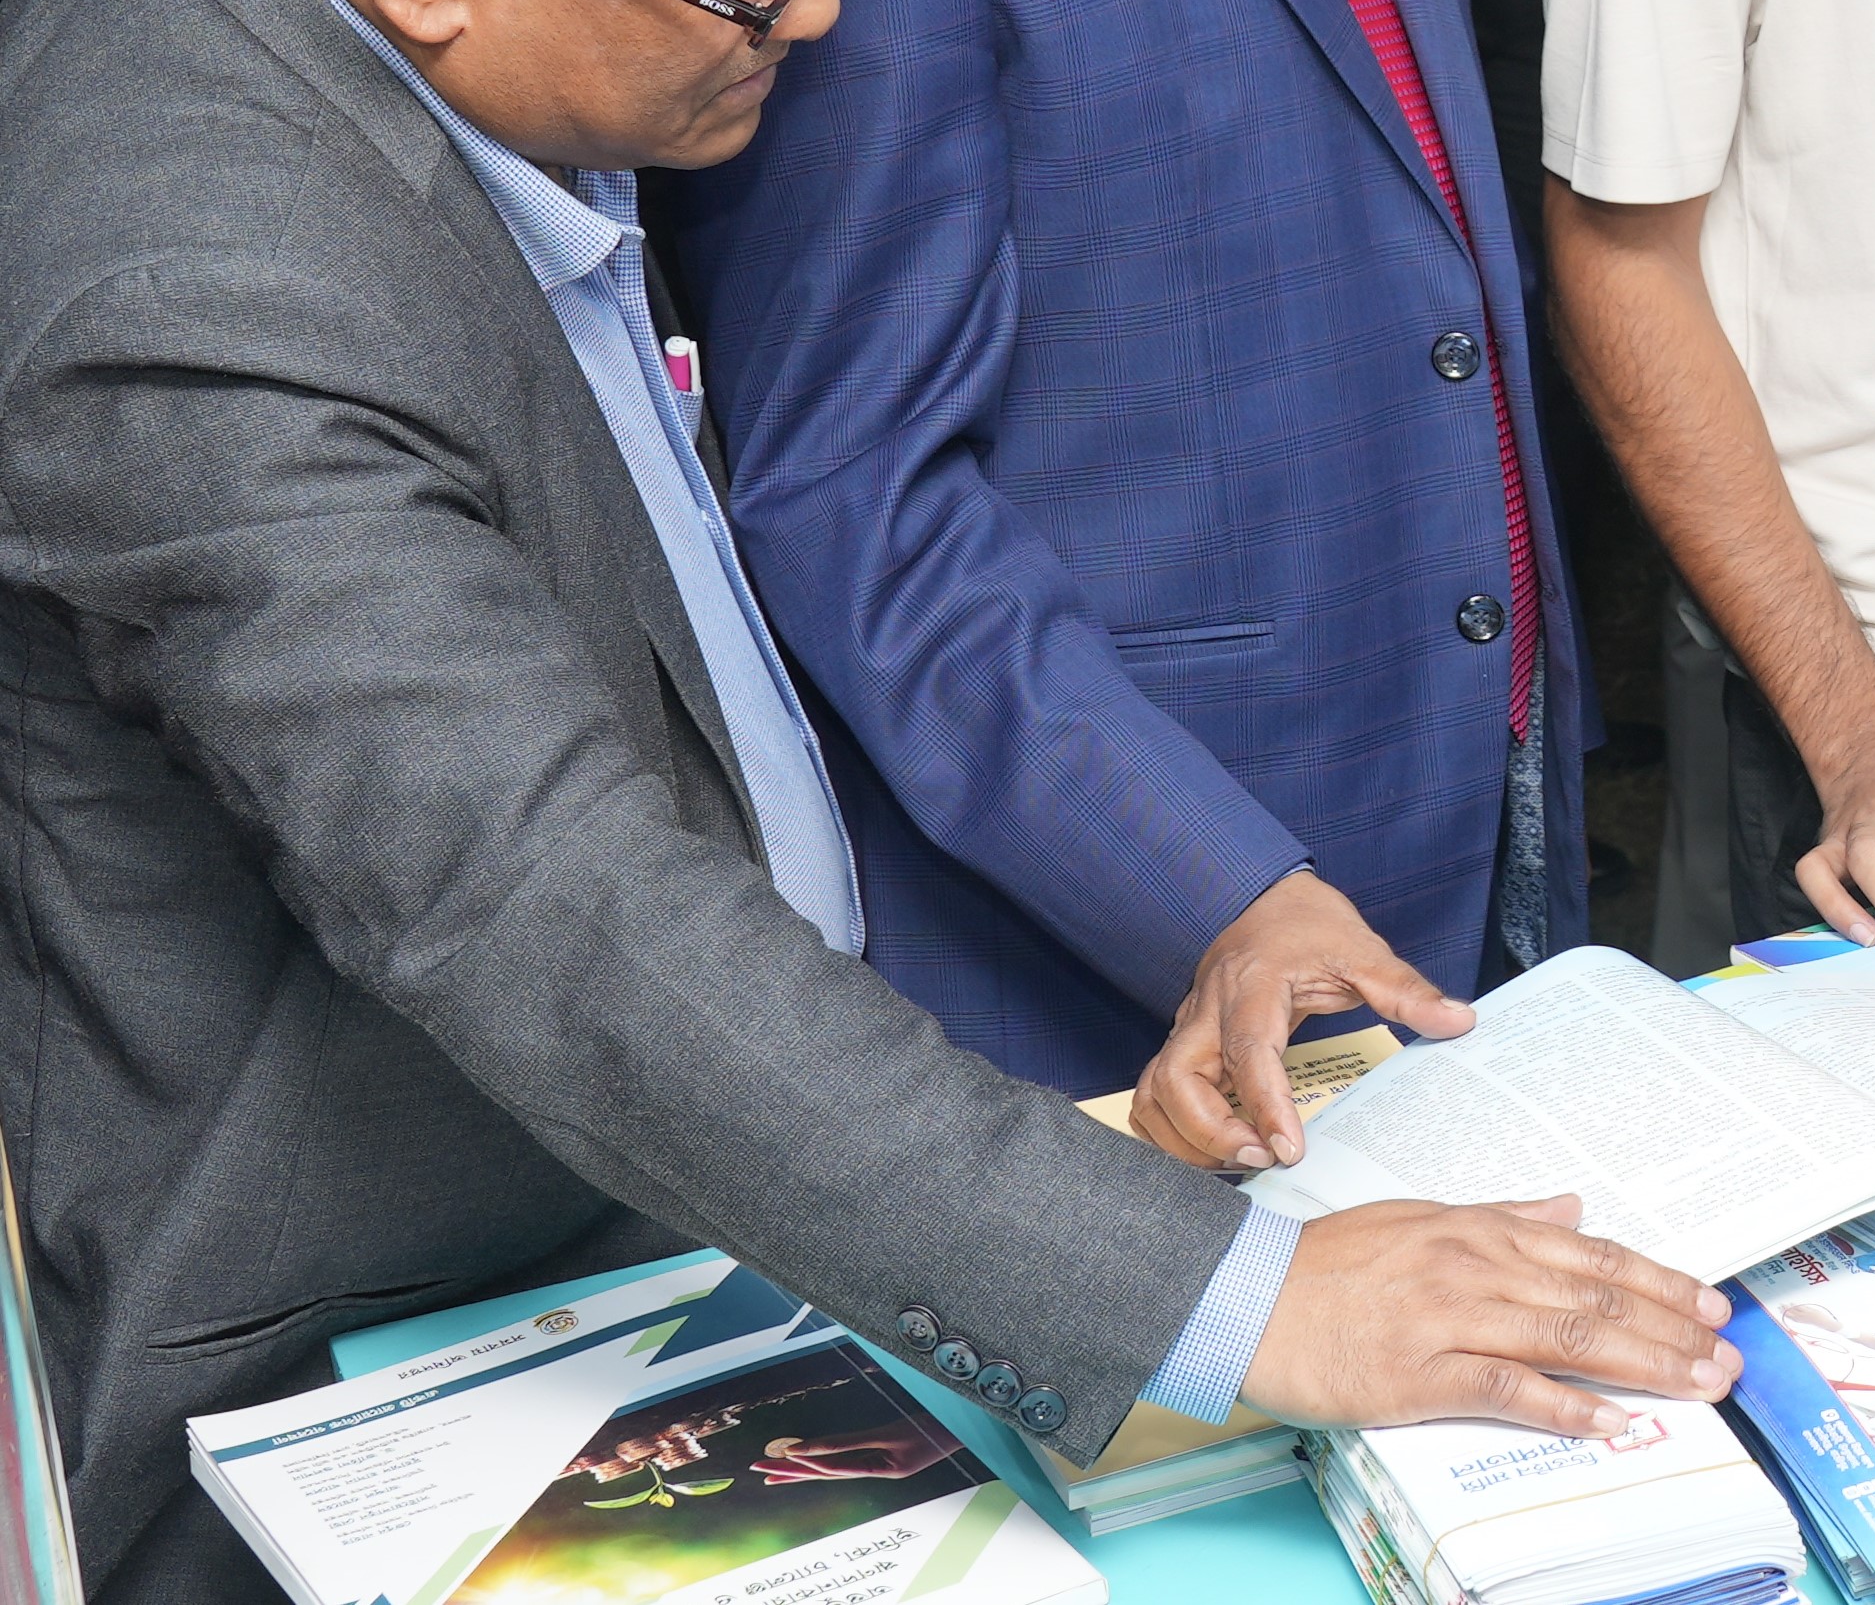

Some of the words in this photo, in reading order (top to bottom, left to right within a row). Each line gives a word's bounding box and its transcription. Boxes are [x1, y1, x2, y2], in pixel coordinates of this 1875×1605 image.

[470, 1334, 526, 1356] সমবায়
[397, 1354, 468, 1380] অধিদপ্তর
[271, 1426, 326, 1446] গবেষণা
[1516, 1451, 1599, 1478] ডিভাইন
[1459, 1470, 1510, 1494] মার্সি
[834, 1528, 920, 1562] ভূমিকা,
[744, 1562, 831, 1595] চ্যালেঞ্জ
[714, 1593, 736, 1604] ও
